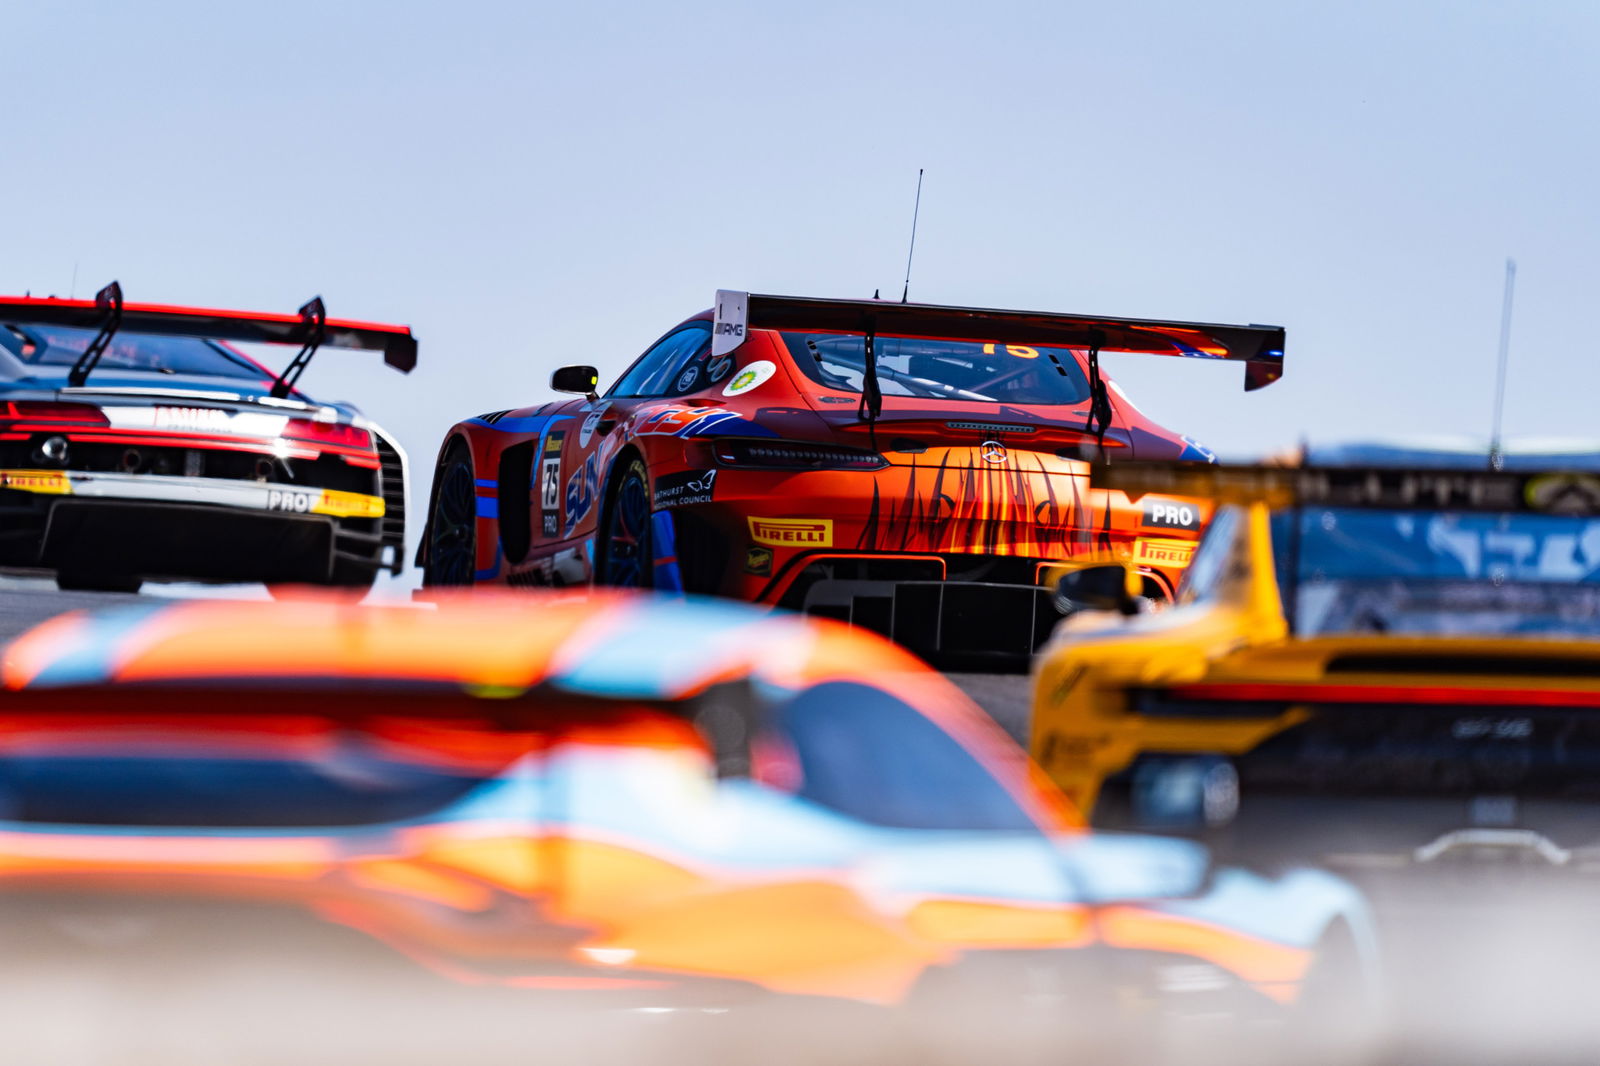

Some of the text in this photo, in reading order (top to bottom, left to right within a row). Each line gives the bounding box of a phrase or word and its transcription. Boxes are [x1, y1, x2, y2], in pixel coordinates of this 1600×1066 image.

[724, 323, 743, 336] AMG
[546, 463, 559, 505] 75
[269, 490, 308, 513] PRO
[679, 496, 712, 505] COUNCIL
[543, 515, 558, 533] PRO
[1152, 504, 1193, 526] PRO
[752, 521, 826, 542] PIRELLI
